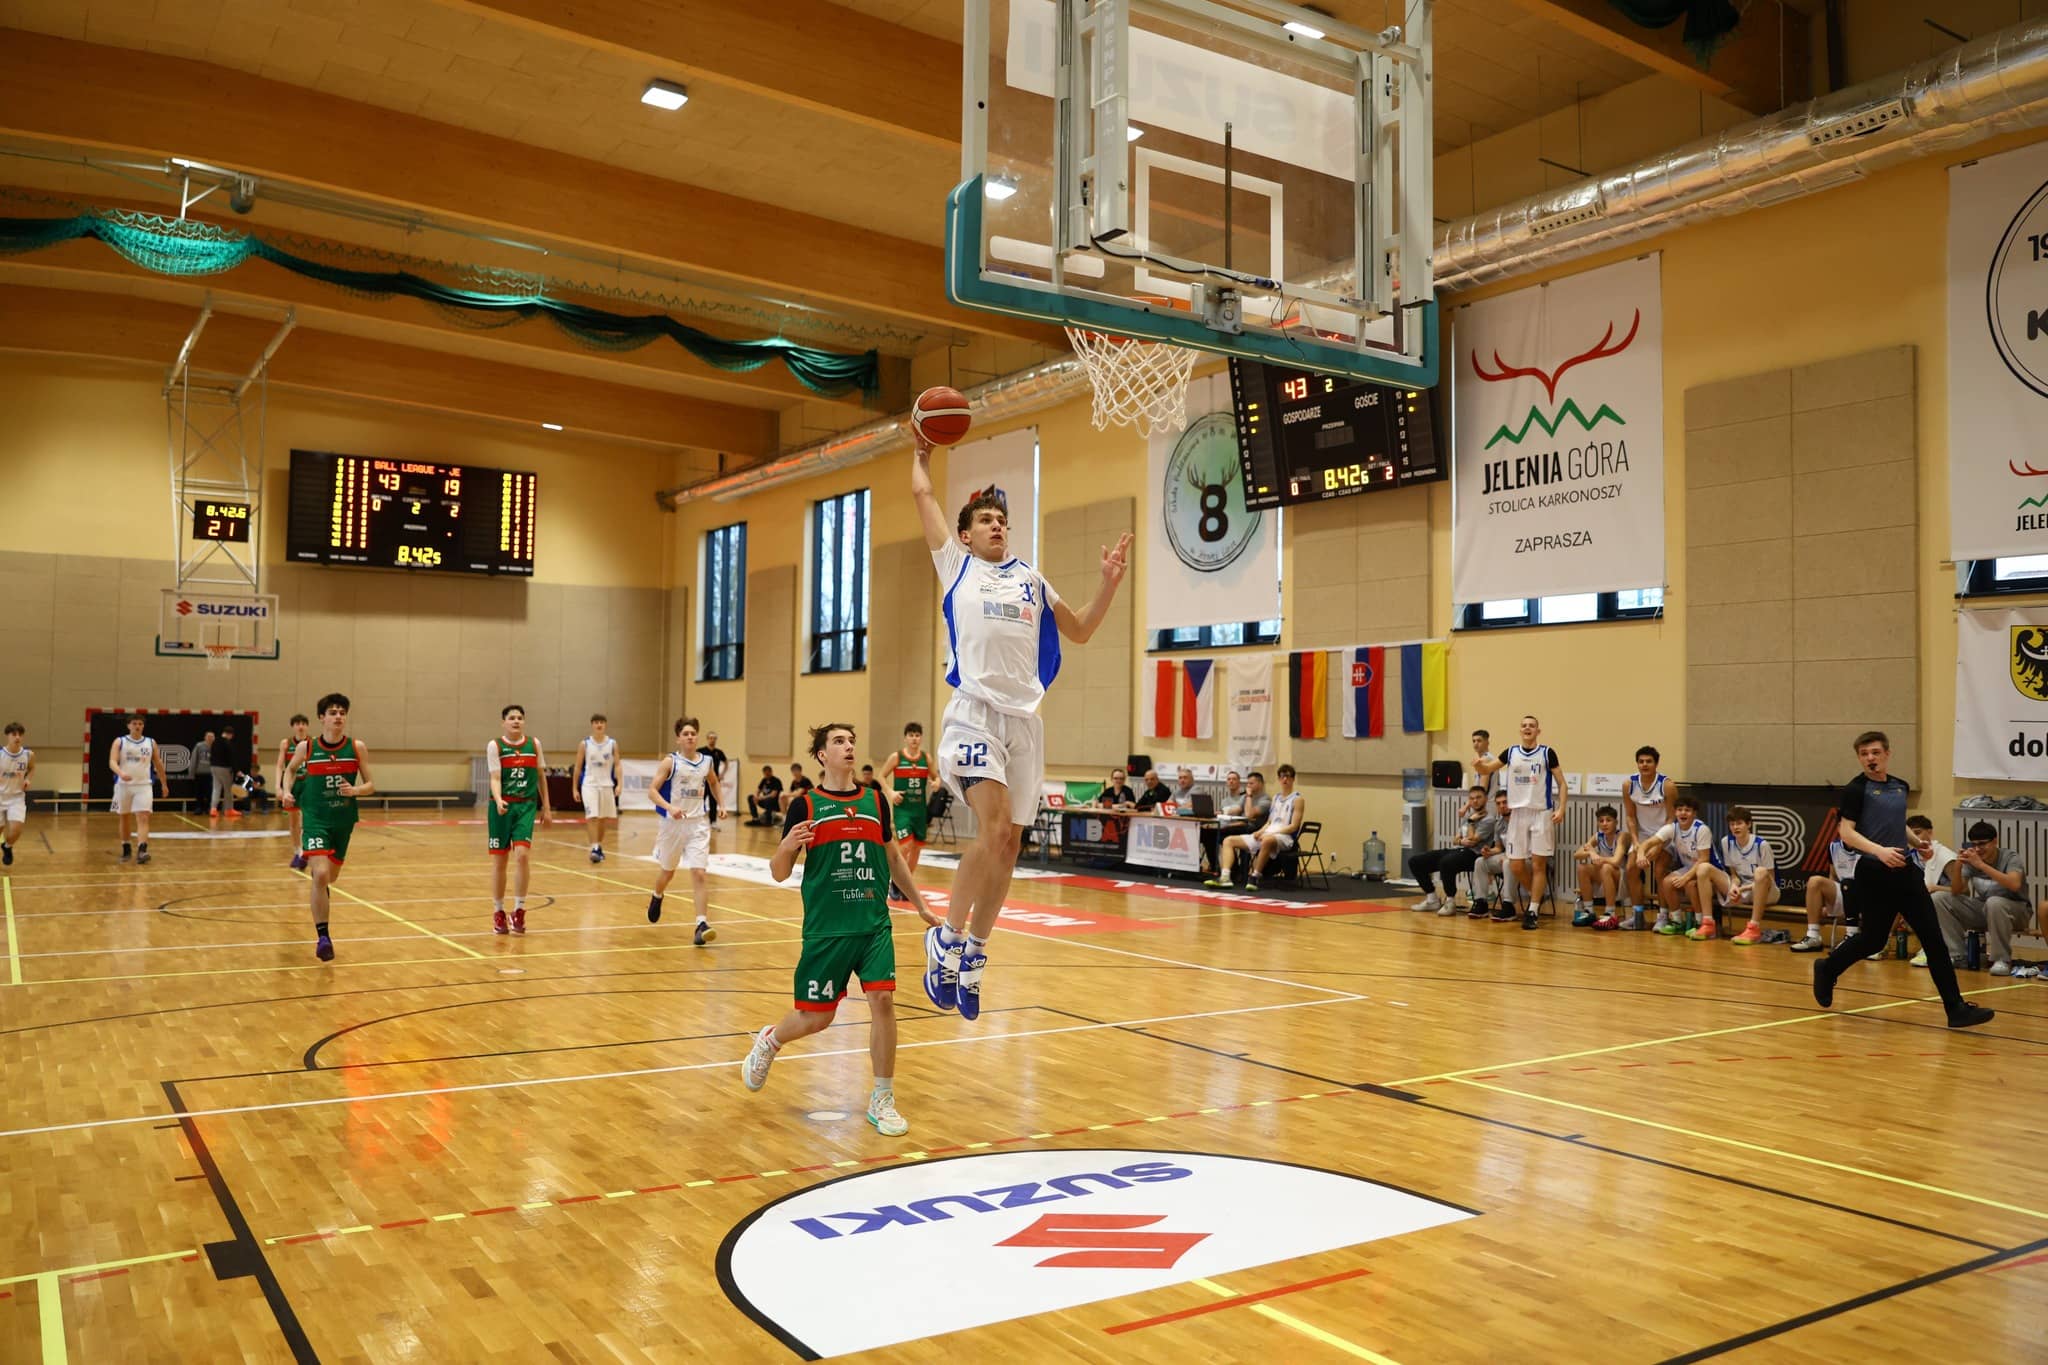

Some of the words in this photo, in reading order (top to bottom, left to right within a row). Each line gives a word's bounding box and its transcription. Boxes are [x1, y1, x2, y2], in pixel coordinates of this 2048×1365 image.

[1284, 377, 1308, 400] 43
[1325, 378, 1334, 393] 2
[1354, 391, 1380, 409] GOŚCIE
[1282, 406, 1322, 425] GOSPODARZE
[374, 460, 398, 472] BALL
[401, 463, 436, 476] LEAGUE
[1385, 465, 1394, 480] 2
[1482, 451, 1563, 495] JELENIA
[1568, 439, 1630, 481] GÓRA
[379, 473, 400, 491] 43
[444, 479, 460, 496] 19
[1291, 482, 1300, 496] 0
[372, 499, 381, 512] 0
[411, 501, 421, 515] 2
[1488, 496, 1536, 515] STOLICA
[1538, 484, 1624, 508] KARKONOSZY
[450, 505, 459, 518] 2
[1198, 483, 1229, 543] 8
[1514, 529, 1593, 554] ZAPRASZA
[197, 603, 267, 617] SUZUKI
[984, 600, 1034, 624] NBA
[957, 742, 988, 767] 32
[326, 775, 343, 788] 22
[510, 767, 526, 778] 26
[908, 777, 920, 788] 25
[896, 828, 909, 839] 25
[1070, 817, 1121, 843] NBA
[1136, 823, 1189, 852] NBA
[307, 837, 325, 851] 22
[840, 841, 867, 864] 24
[856, 867, 876, 881] KUL
[807, 979, 834, 1000] 24
[790, 1161, 1194, 1239] SUZUKI
